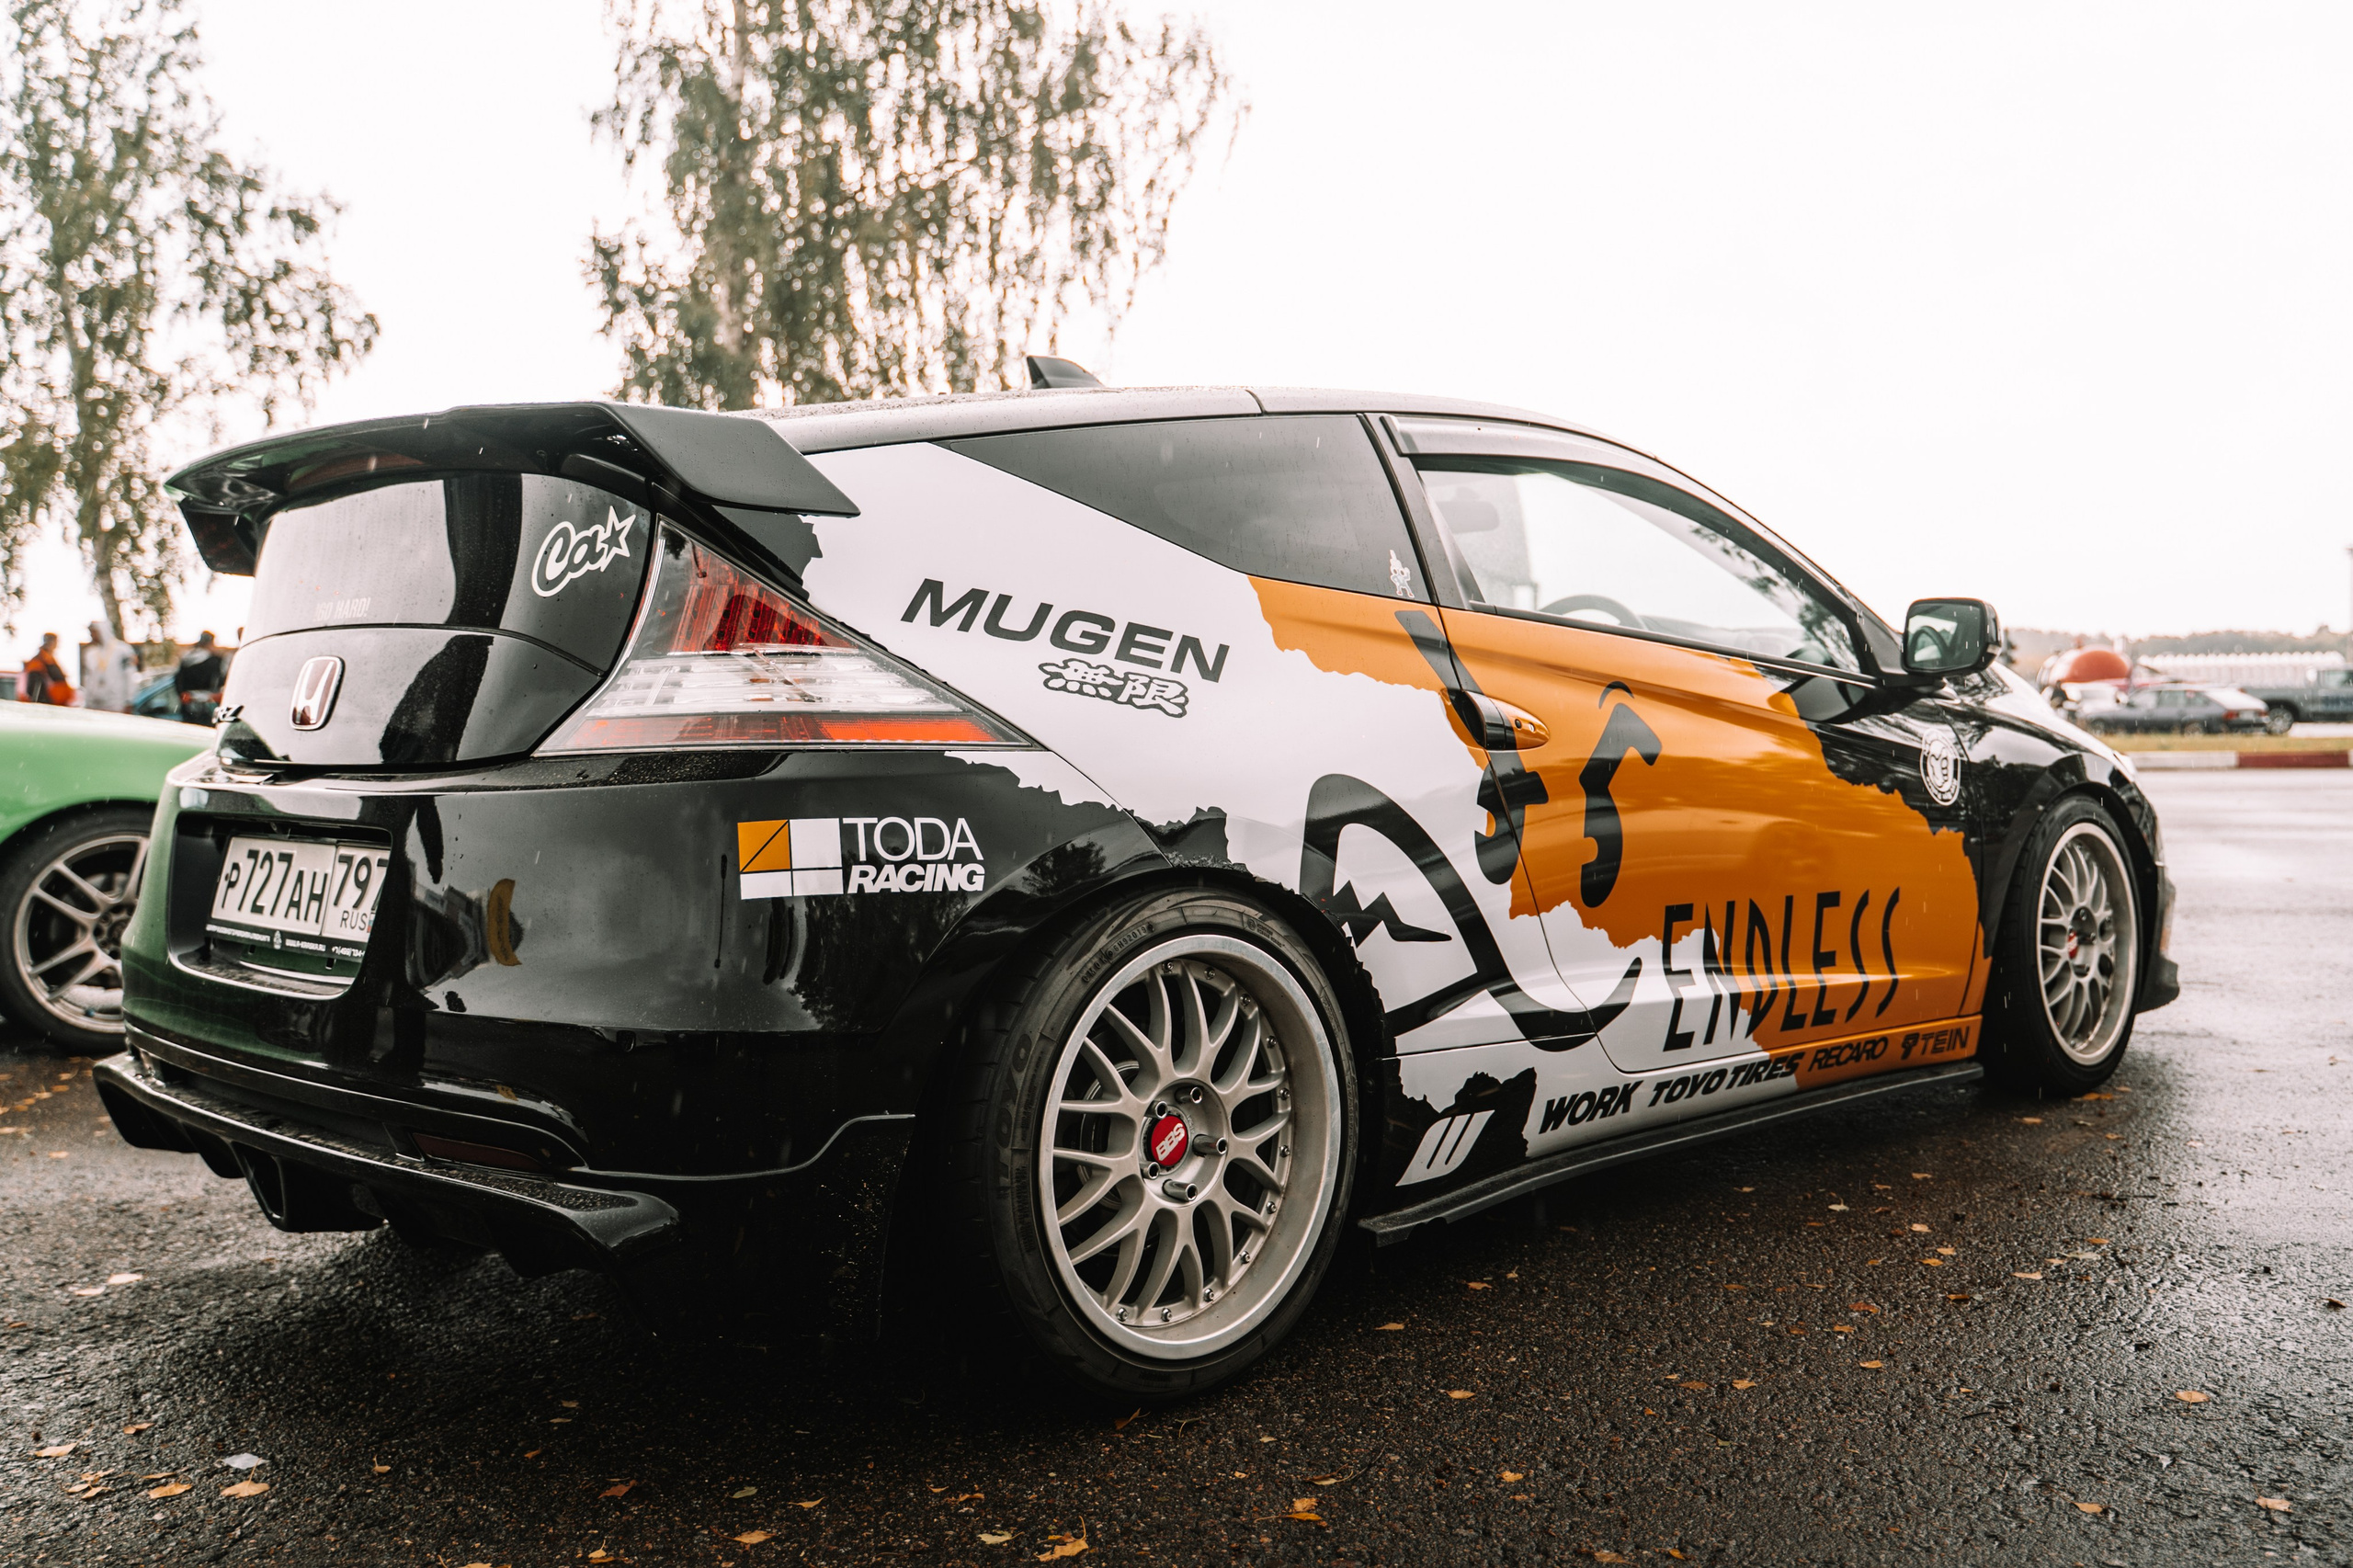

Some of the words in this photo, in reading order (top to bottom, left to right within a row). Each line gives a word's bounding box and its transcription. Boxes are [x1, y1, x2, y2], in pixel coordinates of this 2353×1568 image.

[900, 577, 1230, 684] MUGEN
[1038, 658, 1189, 719] 無限
[842, 816, 984, 861] TODA
[847, 863, 985, 894] RACING
[340, 910, 367, 931] RUS
[1662, 886, 1900, 1052] ENDLESS
[1538, 1080, 1643, 1135] WORK
[1808, 1036, 1889, 1073] RECARO
[1921, 1026, 1970, 1056] TEIN
[1155, 1122, 1186, 1162] BBS
